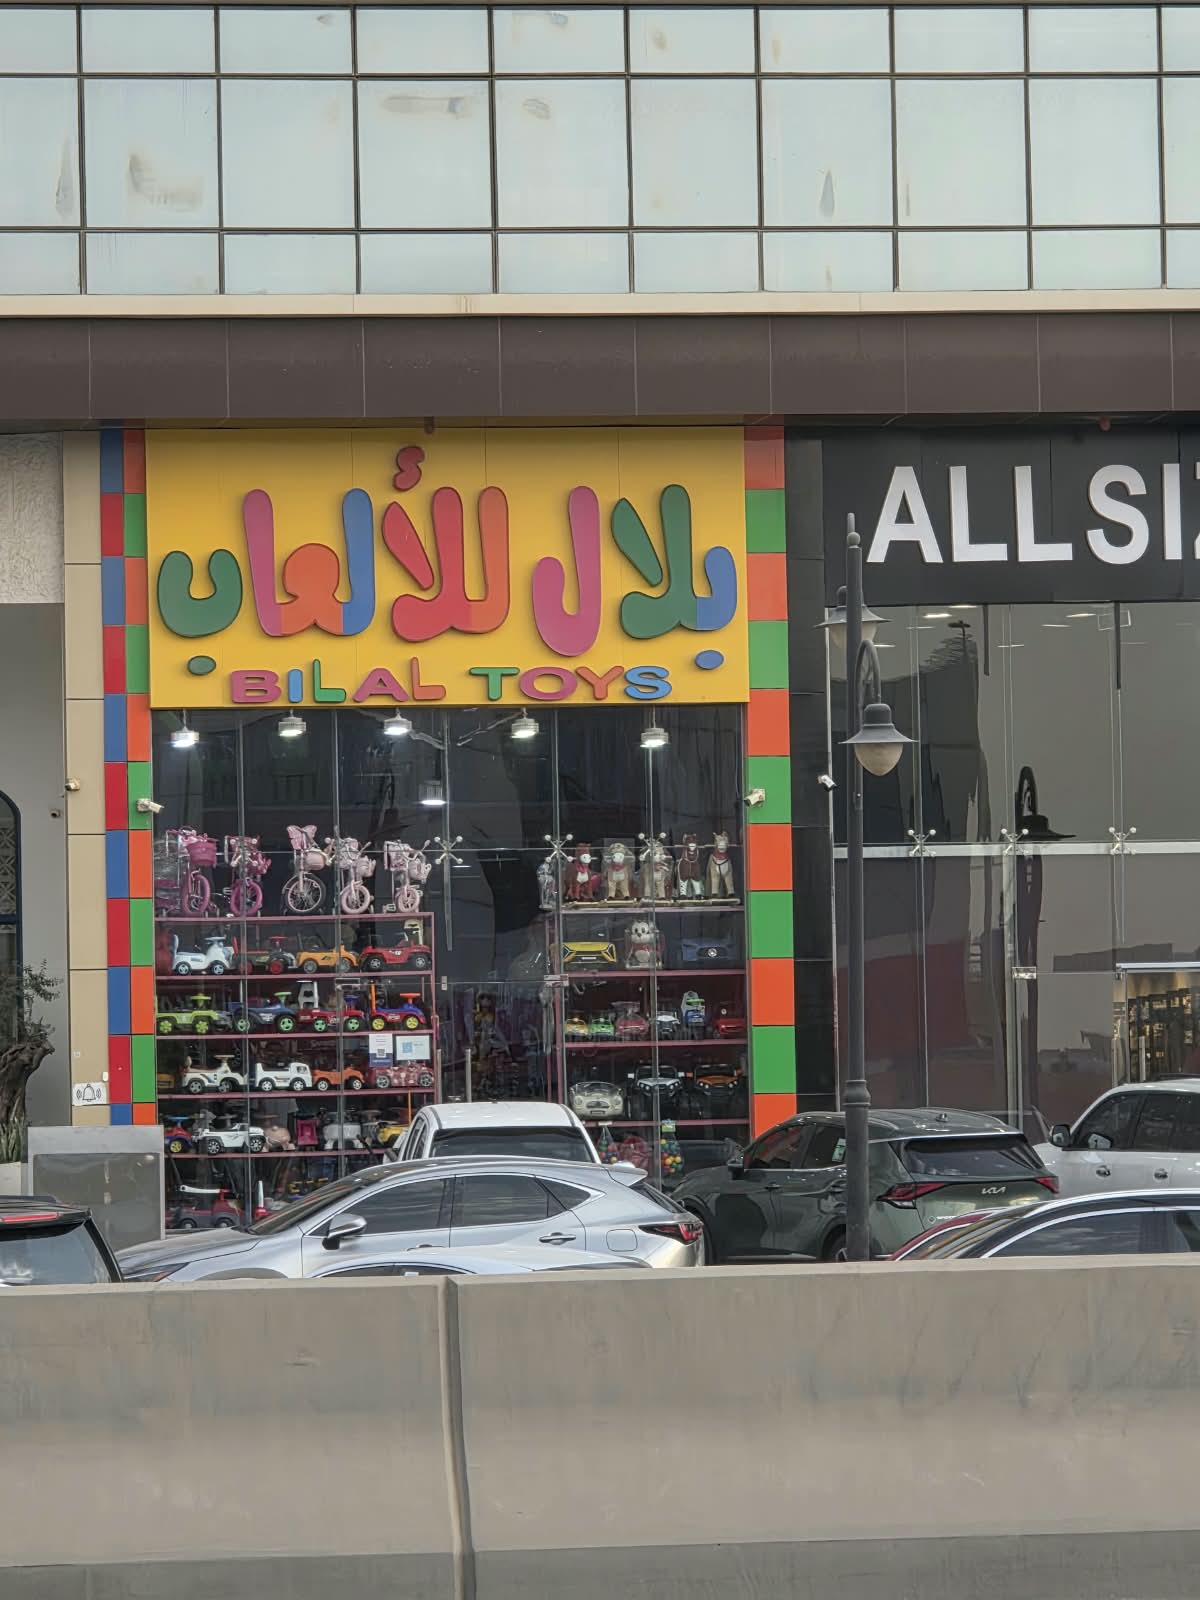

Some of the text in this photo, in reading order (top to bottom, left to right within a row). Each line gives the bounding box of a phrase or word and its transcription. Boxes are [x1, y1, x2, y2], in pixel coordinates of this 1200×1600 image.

[532, 484, 737, 670] بلال
[231, 656, 673, 703] BILAL TOYS
